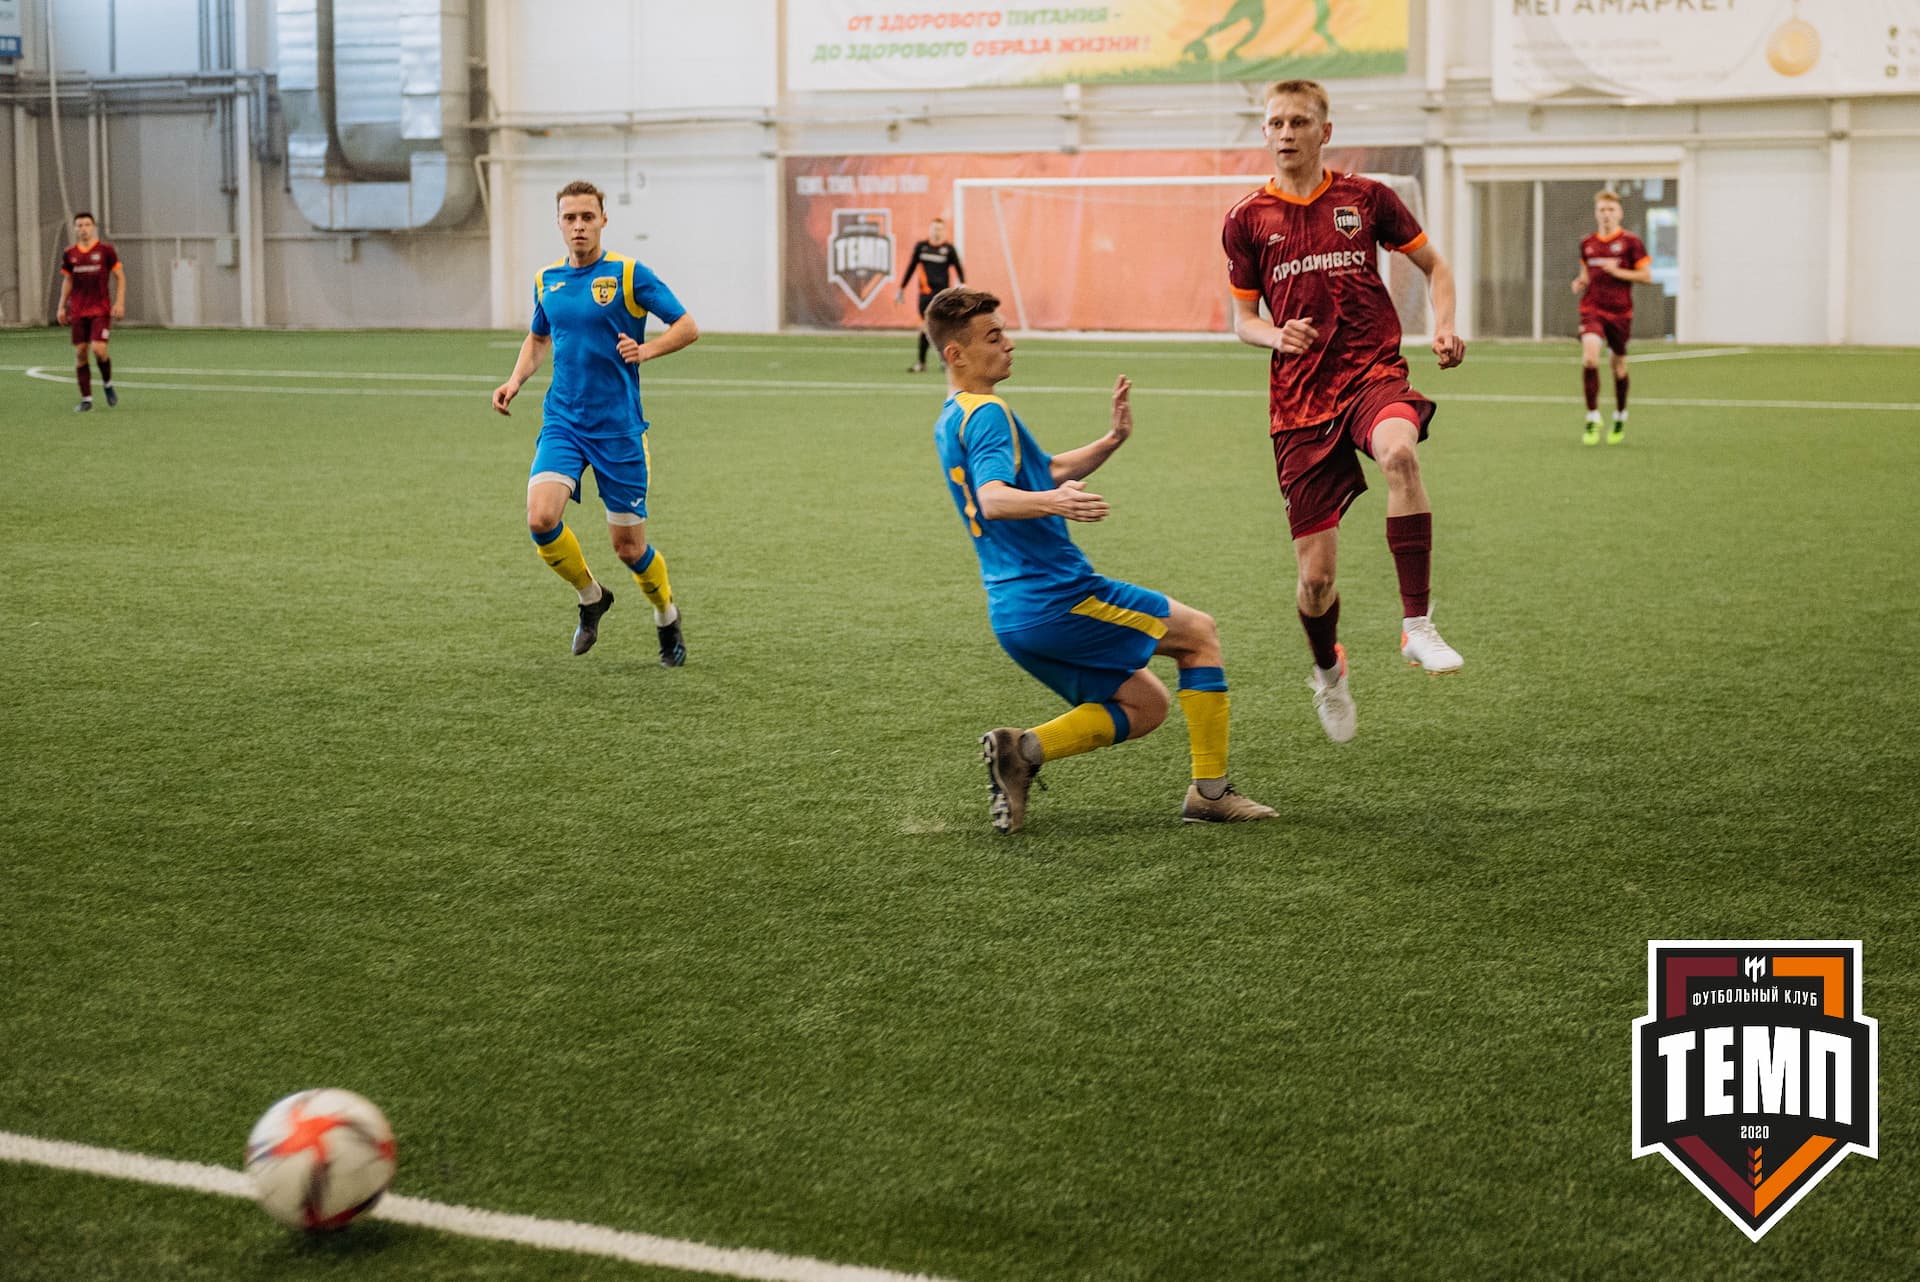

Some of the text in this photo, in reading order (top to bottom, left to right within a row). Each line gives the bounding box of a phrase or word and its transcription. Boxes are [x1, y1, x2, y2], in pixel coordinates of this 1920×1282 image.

[847, 15, 874, 32] ОТ
[878, 11, 1002, 32] ЗДОРОВОГО
[1007, 7, 1109, 26] ПИТАНИЯ
[812, 43, 842, 63] ДО
[846, 41, 967, 61] ЗДОРОВОГО
[972, 37, 1052, 57] ОБРАЗА
[835, 237, 888, 272] ТЕМП
